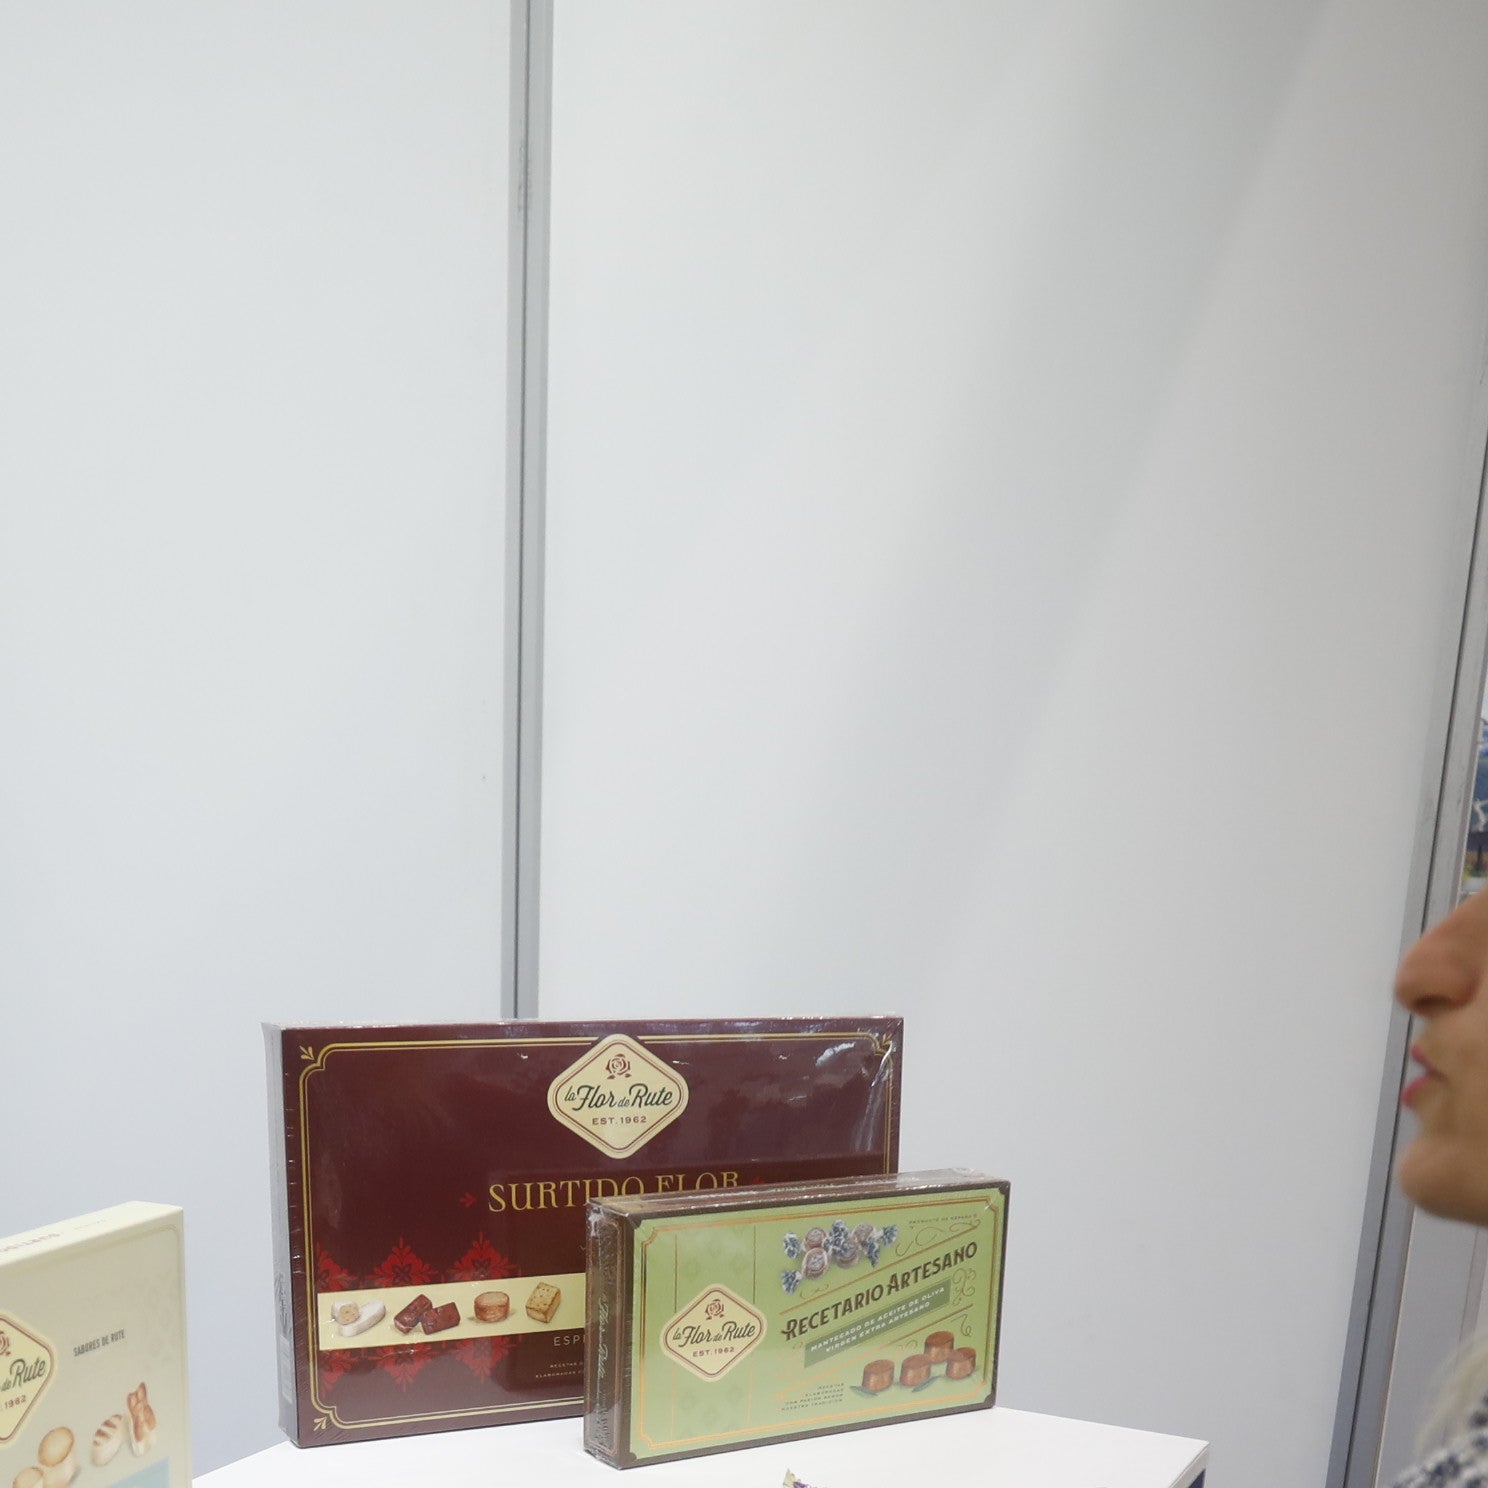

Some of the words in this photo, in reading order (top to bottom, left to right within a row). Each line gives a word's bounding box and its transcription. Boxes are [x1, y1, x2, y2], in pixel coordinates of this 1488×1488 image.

[565, 1085, 576, 1102] la
[572, 1085, 617, 1112] Flor
[617, 1097, 630, 1108] de
[628, 1083, 673, 1109] Rute
[620, 1116, 647, 1124] 1962
[488, 1176, 645, 1212] SURTIDO
[781, 1284, 884, 1340] RECETARIO
[886, 1241, 978, 1296] ARTESANO
[811, 1324, 862, 1352] MANTECADO
[877, 1304, 906, 1322] ACEITE
[921, 1286, 946, 1303] OLIVA
[73, 1340, 100, 1357] SABORES
[101, 1335, 109, 1346] DE
[111, 1328, 125, 1343] RUTE
[678, 1325, 712, 1348] Flor
[721, 1321, 756, 1341] Rute
[825, 1335, 858, 1353] VIRGEN
[859, 1321, 886, 1338] EXTRA
[9, 1357, 46, 1387] Rute
